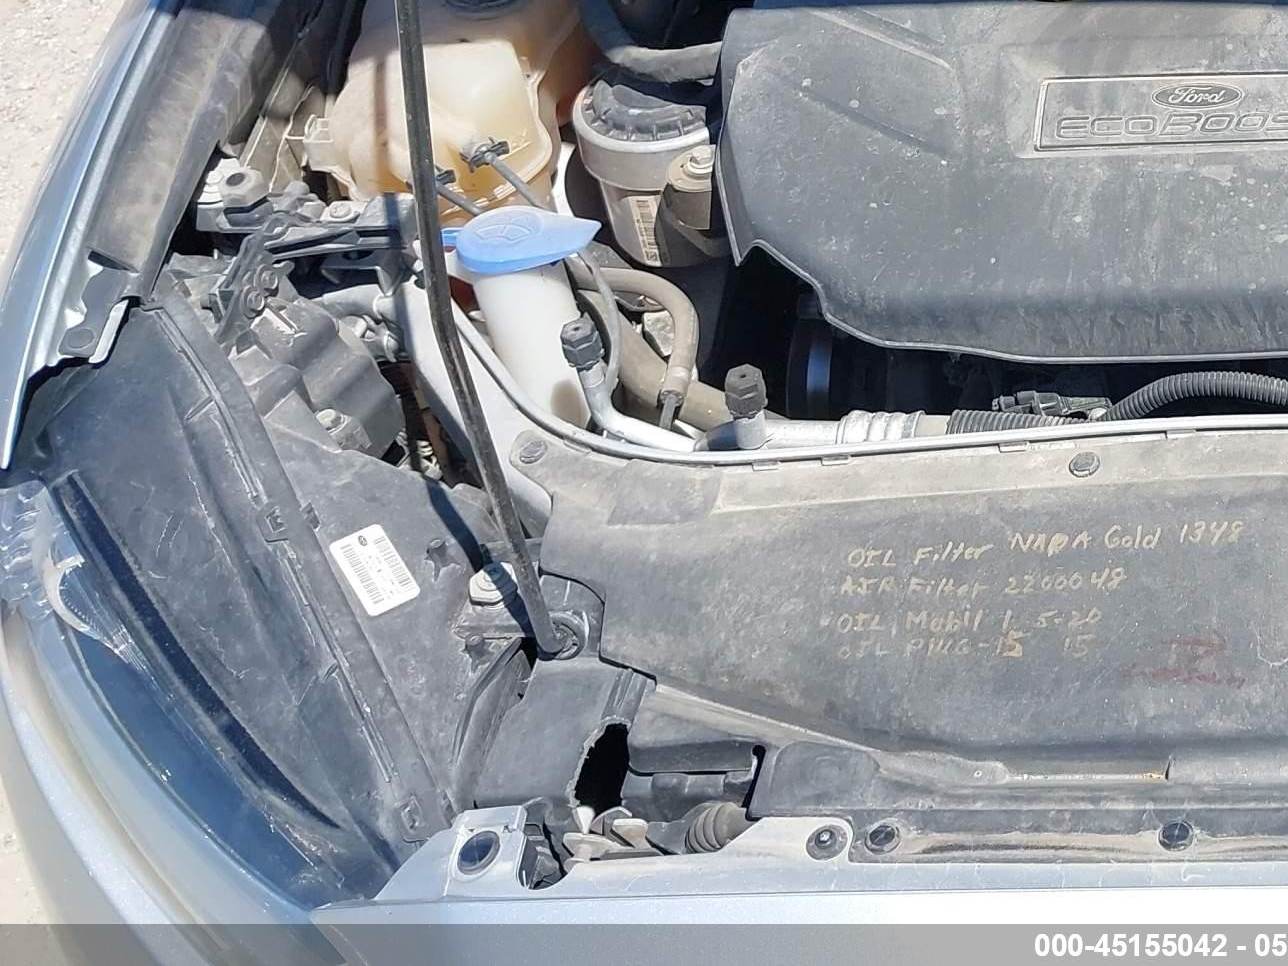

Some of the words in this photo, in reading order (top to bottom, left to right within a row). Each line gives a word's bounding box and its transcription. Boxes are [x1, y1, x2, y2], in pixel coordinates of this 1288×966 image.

[1168, 84, 1224, 103] Ford
[848, 548, 896, 568] OIL
[914, 541, 994, 566] Filter
[1008, 531, 1092, 556] NAPA
[1104, 524, 1162, 549] Gold
[840, 575, 896, 596] AIR
[908, 577, 990, 600] Filter
[836, 612, 886, 633] OIL
